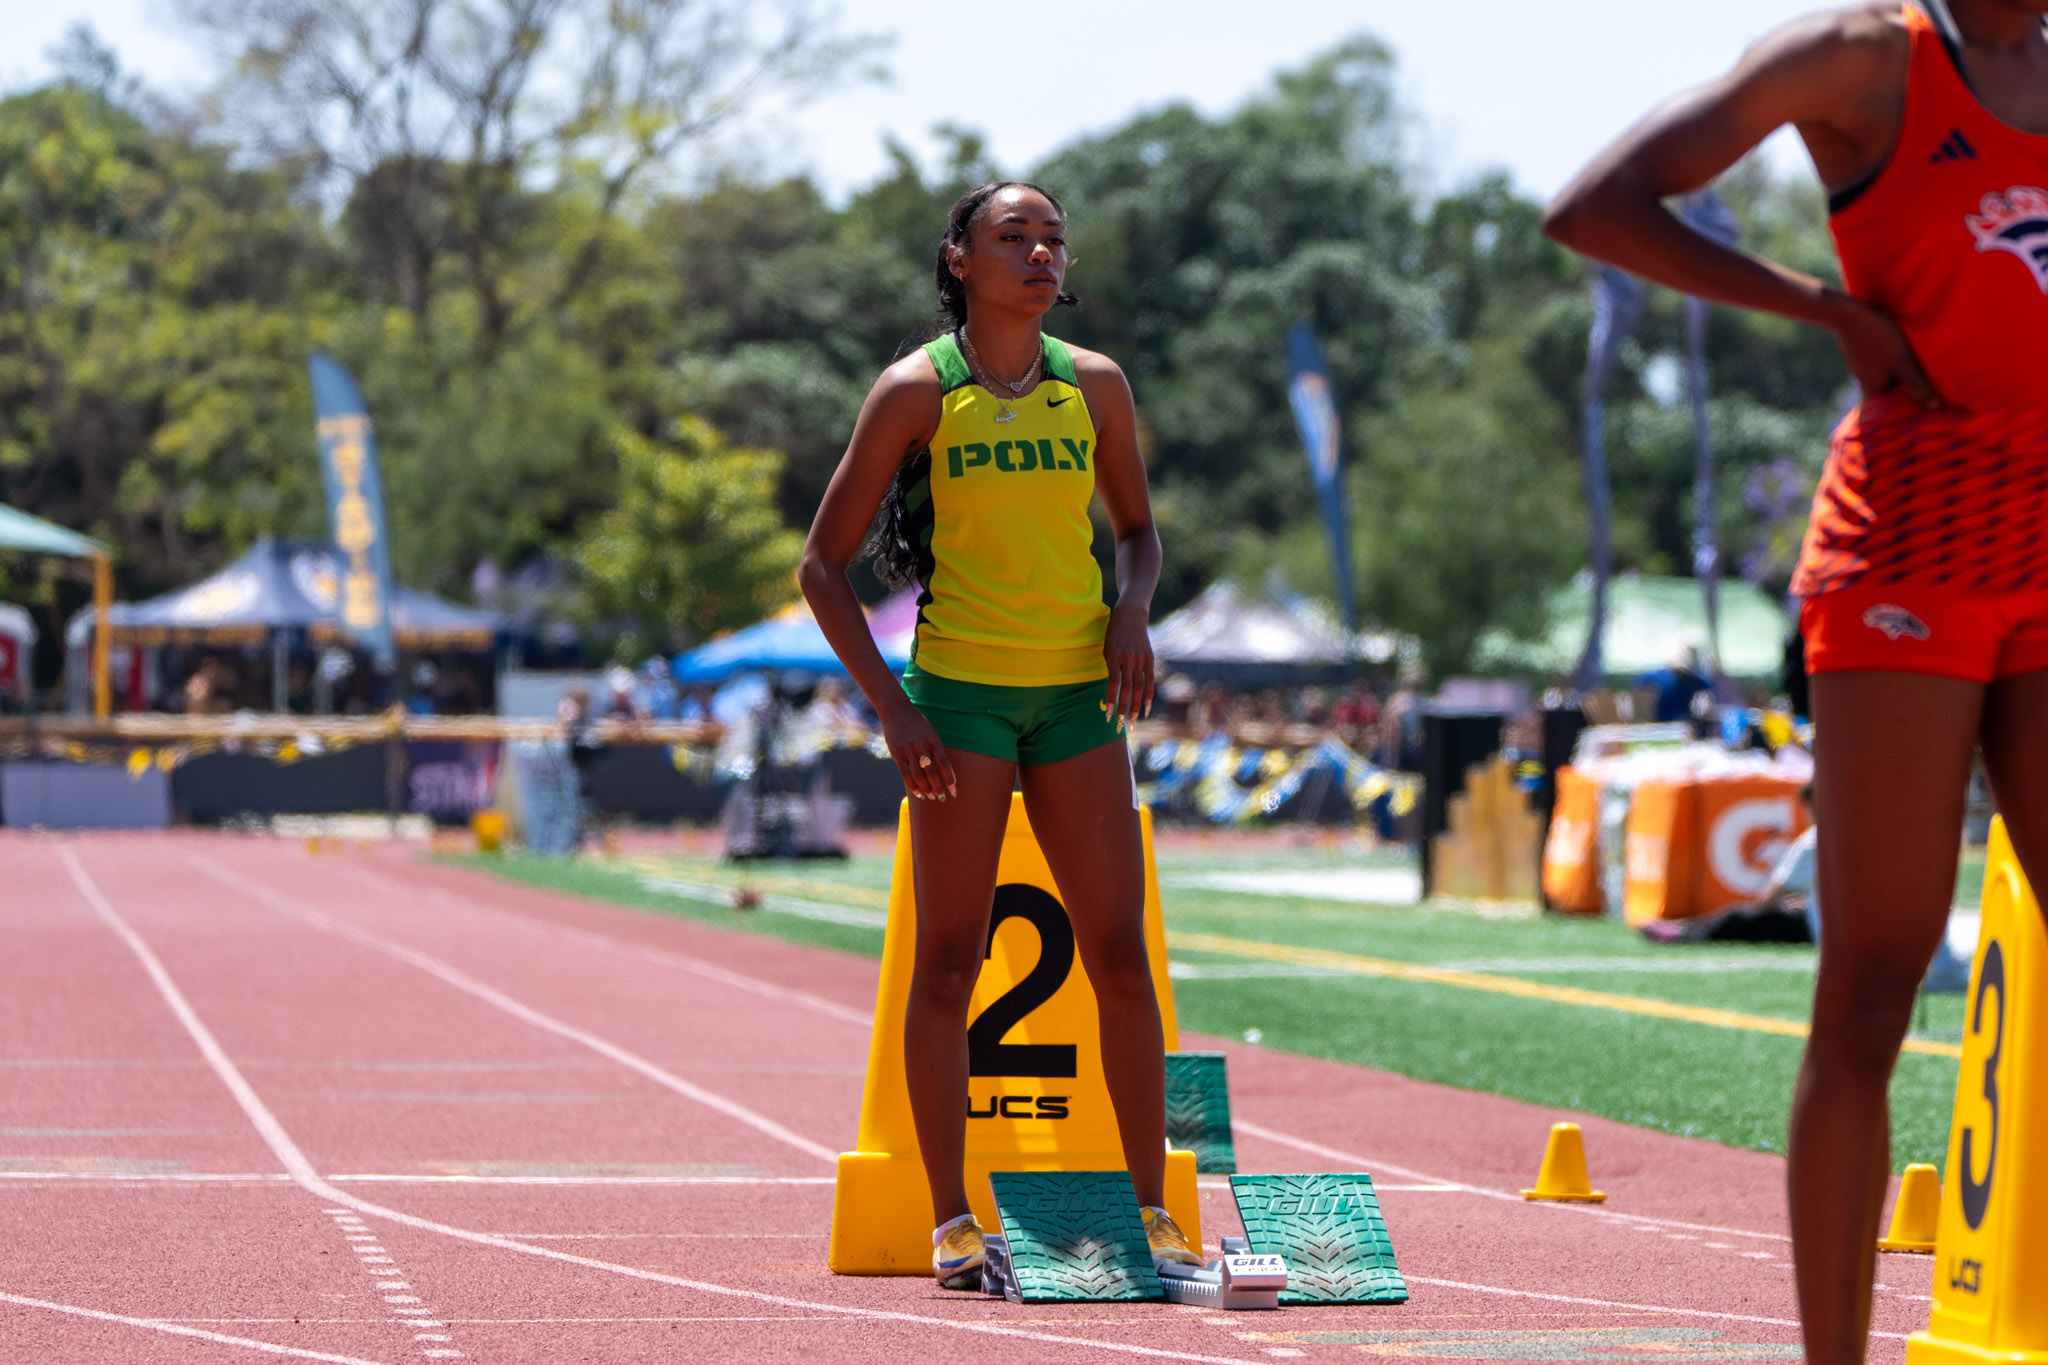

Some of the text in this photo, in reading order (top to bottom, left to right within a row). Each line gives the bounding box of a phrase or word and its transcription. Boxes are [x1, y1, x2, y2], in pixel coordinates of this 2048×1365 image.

[946, 438, 1089, 479] POLY
[1708, 797, 1795, 897] G
[967, 883, 1077, 1078] 2
[1960, 939, 2005, 1231] 3
[967, 1095, 1069, 1119] UCS
[1269, 1197, 1355, 1215] GILL
[1232, 1257, 1279, 1266] GILL
